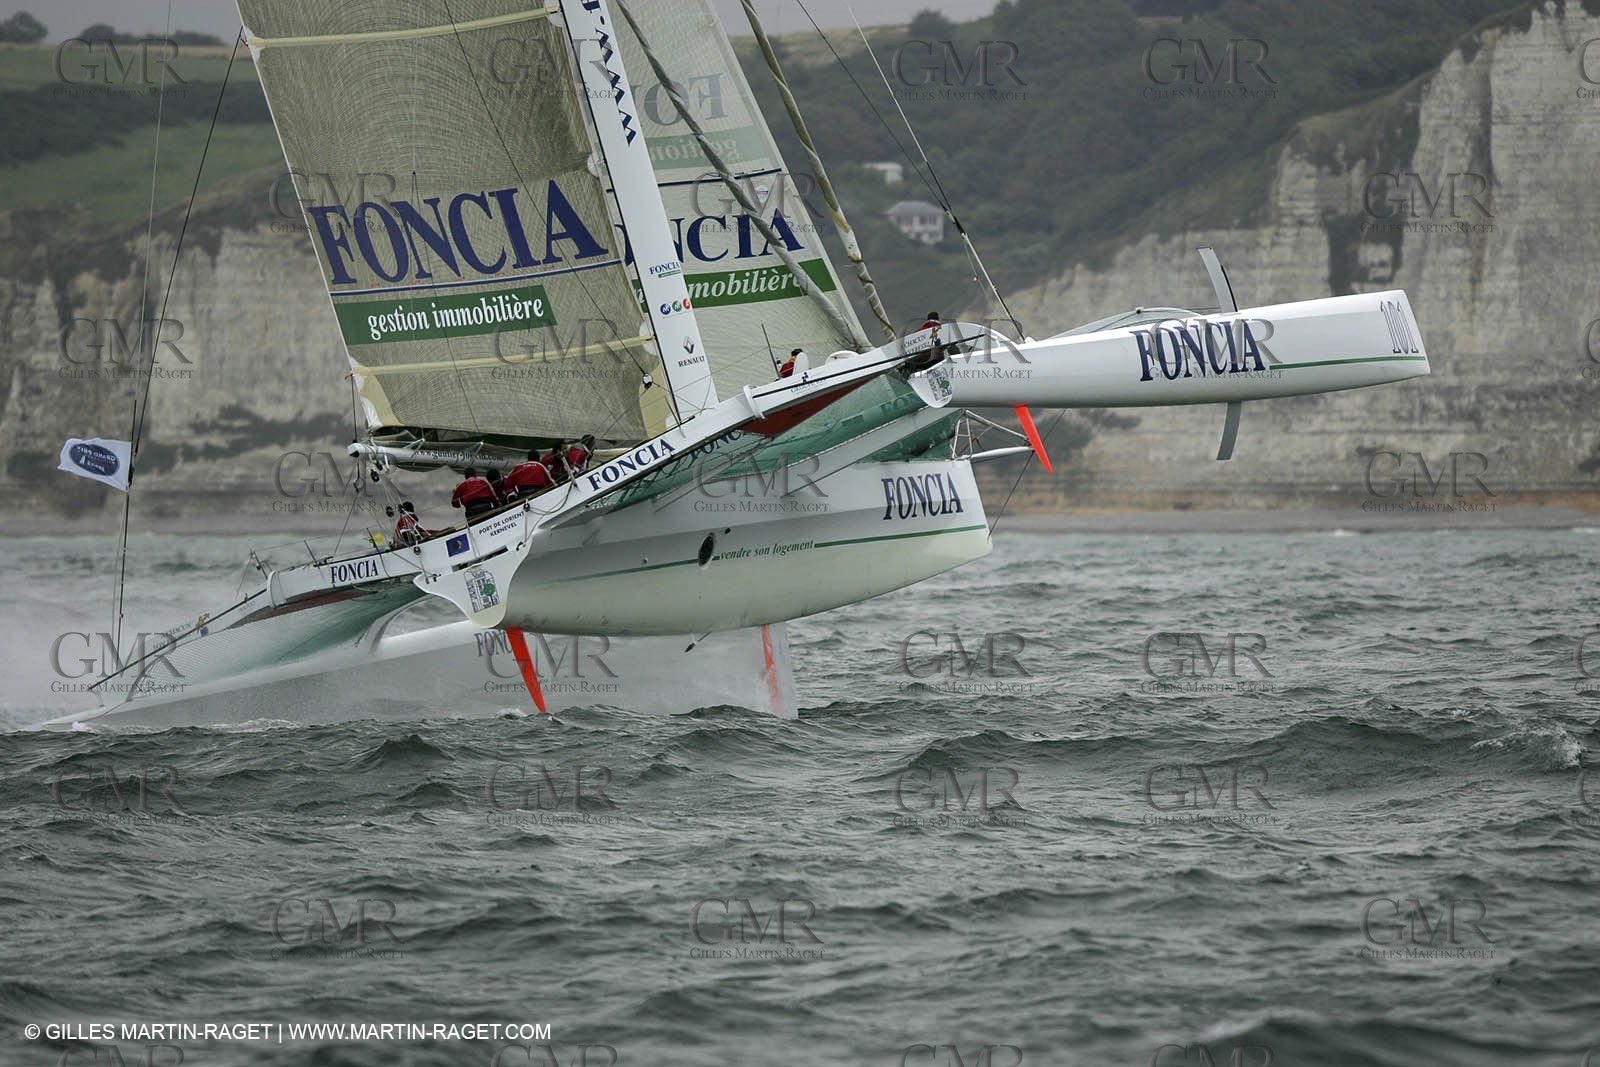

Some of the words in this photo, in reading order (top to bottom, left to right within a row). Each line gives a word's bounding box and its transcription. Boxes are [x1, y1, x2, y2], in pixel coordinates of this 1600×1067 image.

[305, 180, 608, 284] FONCIA
[368, 305, 430, 341] gestion
[432, 294, 543, 328] immobilière
[1129, 319, 1265, 381] FONCIA
[587, 438, 676, 491] FONCIA
[881, 472, 964, 520] FONCIA
[330, 560, 378, 584] FONCIA
[720, 547, 751, 560] vendre
[754, 547, 771, 557] son
[773, 540, 814, 556] logement
